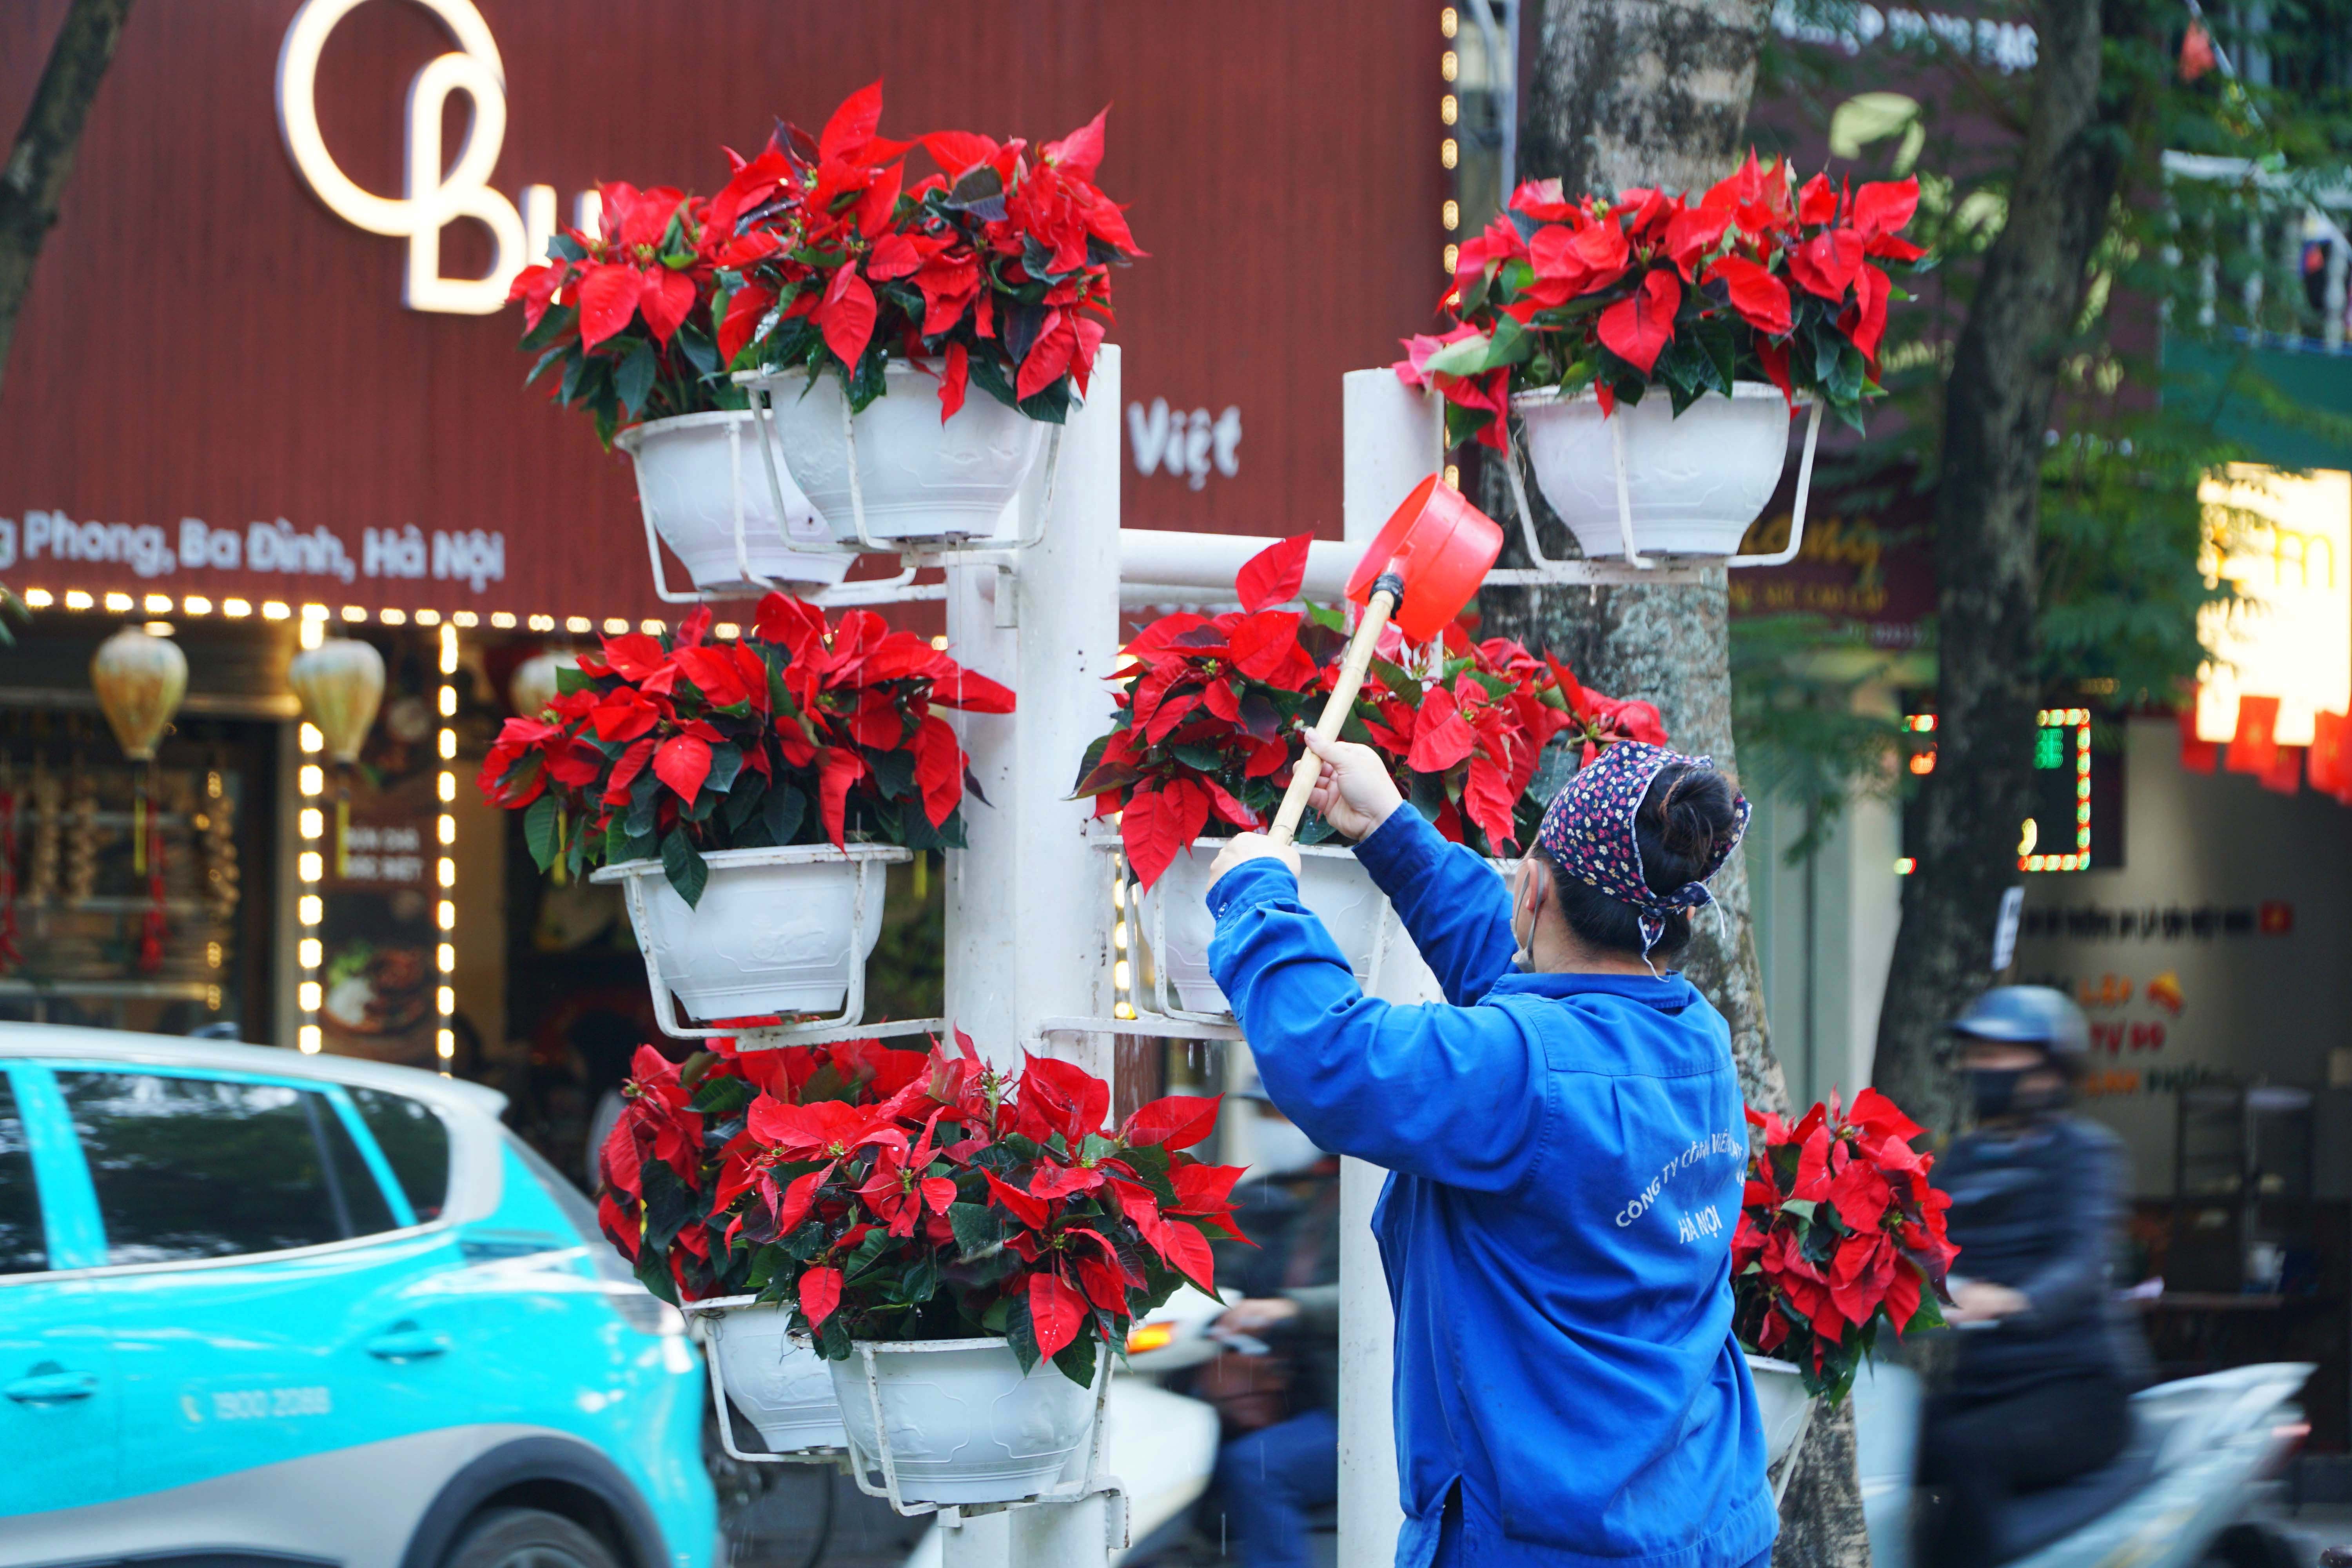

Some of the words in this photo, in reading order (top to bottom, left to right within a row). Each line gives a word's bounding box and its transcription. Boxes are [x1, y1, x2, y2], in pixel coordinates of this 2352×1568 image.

[1127, 396, 1242, 492] Việt
[23, 509, 176, 578] Phong,
[179, 517, 241, 570] Ba
[245, 516, 356, 585] Đình,
[362, 523, 426, 579] Hà
[433, 528, 505, 593] Nội
[1615, 1176, 1661, 1227] CÔNG
[1662, 1156, 1678, 1184] TY
[1678, 1211, 1700, 1244] HÀ
[1695, 1205, 1722, 1238] NỘI
